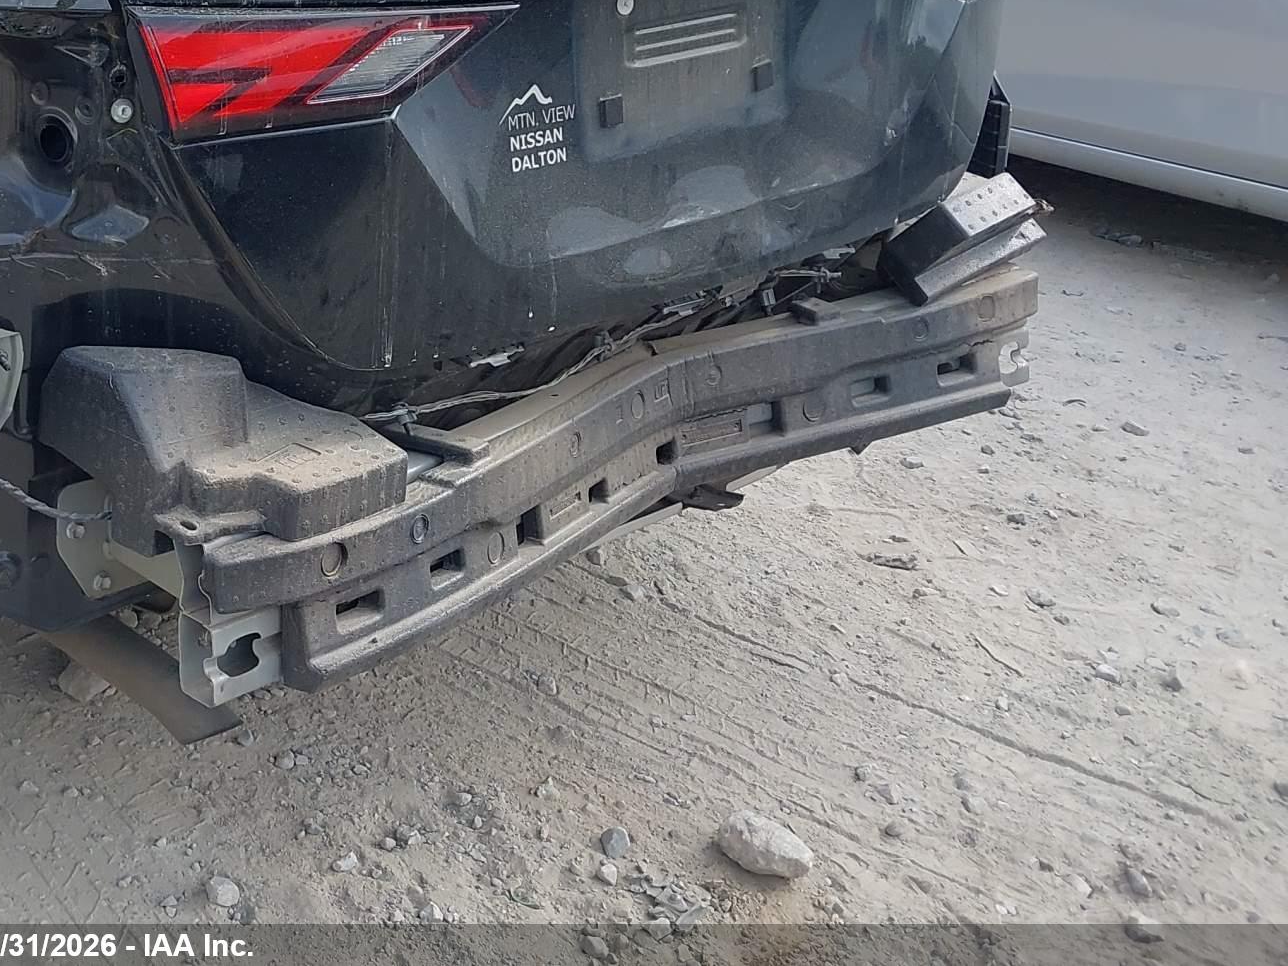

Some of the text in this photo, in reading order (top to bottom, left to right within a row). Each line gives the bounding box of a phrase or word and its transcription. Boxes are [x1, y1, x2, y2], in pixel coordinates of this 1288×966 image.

[508, 103, 576, 132] MTN. VIEW
[509, 127, 564, 152] NISSAN
[511, 147, 567, 172] DALTON
